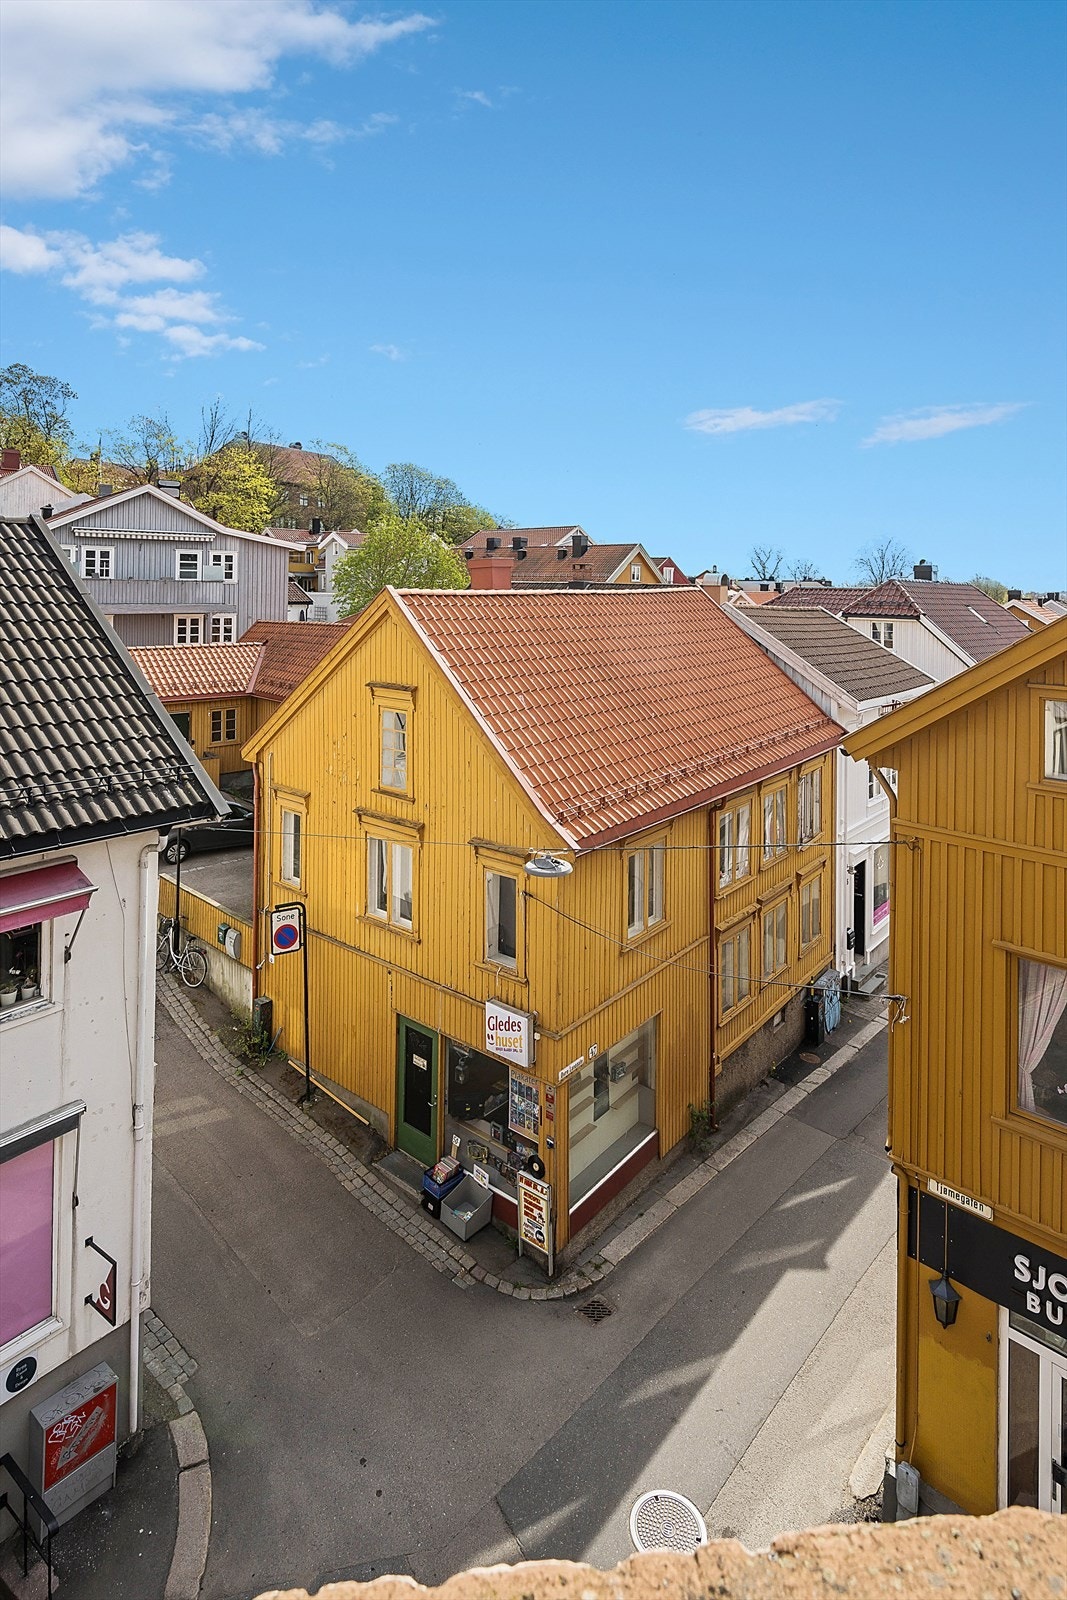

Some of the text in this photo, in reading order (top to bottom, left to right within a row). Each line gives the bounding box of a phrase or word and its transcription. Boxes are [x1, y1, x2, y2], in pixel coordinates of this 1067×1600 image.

[276, 914, 295, 922] Sone
[487, 1015, 522, 1032] Gledes
[495, 1032, 523, 1048] huset
[510, 1069, 539, 1085] Plakater
[935, 1181, 984, 1212] Tjømegaten
[1026, 1290, 1064, 1326] BU
